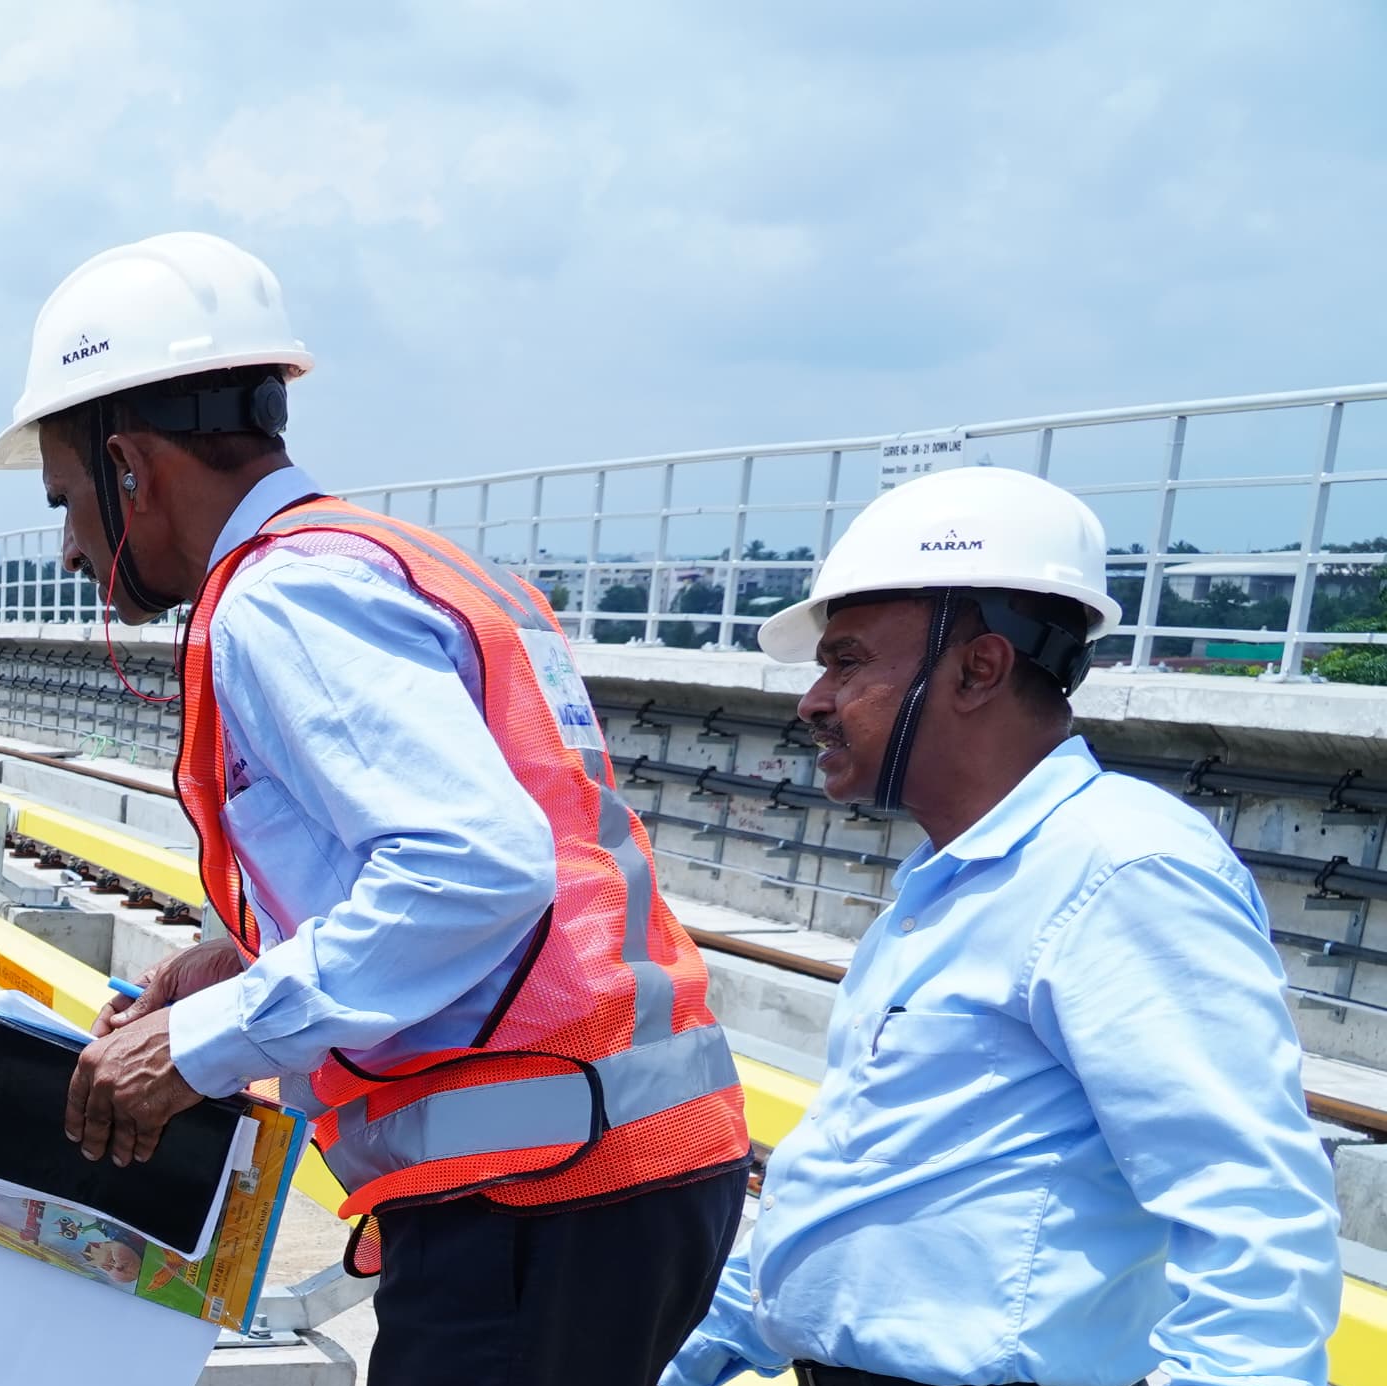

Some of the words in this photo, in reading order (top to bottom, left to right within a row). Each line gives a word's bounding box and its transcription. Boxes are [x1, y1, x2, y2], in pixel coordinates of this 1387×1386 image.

[62, 341, 110, 365] KARAM
[883, 445, 900, 457] CURVE
[900, 444, 908, 456] NO
[932, 441, 948, 454] DOWN
[949, 440, 962, 452] LINE
[920, 541, 983, 551] KARAM
